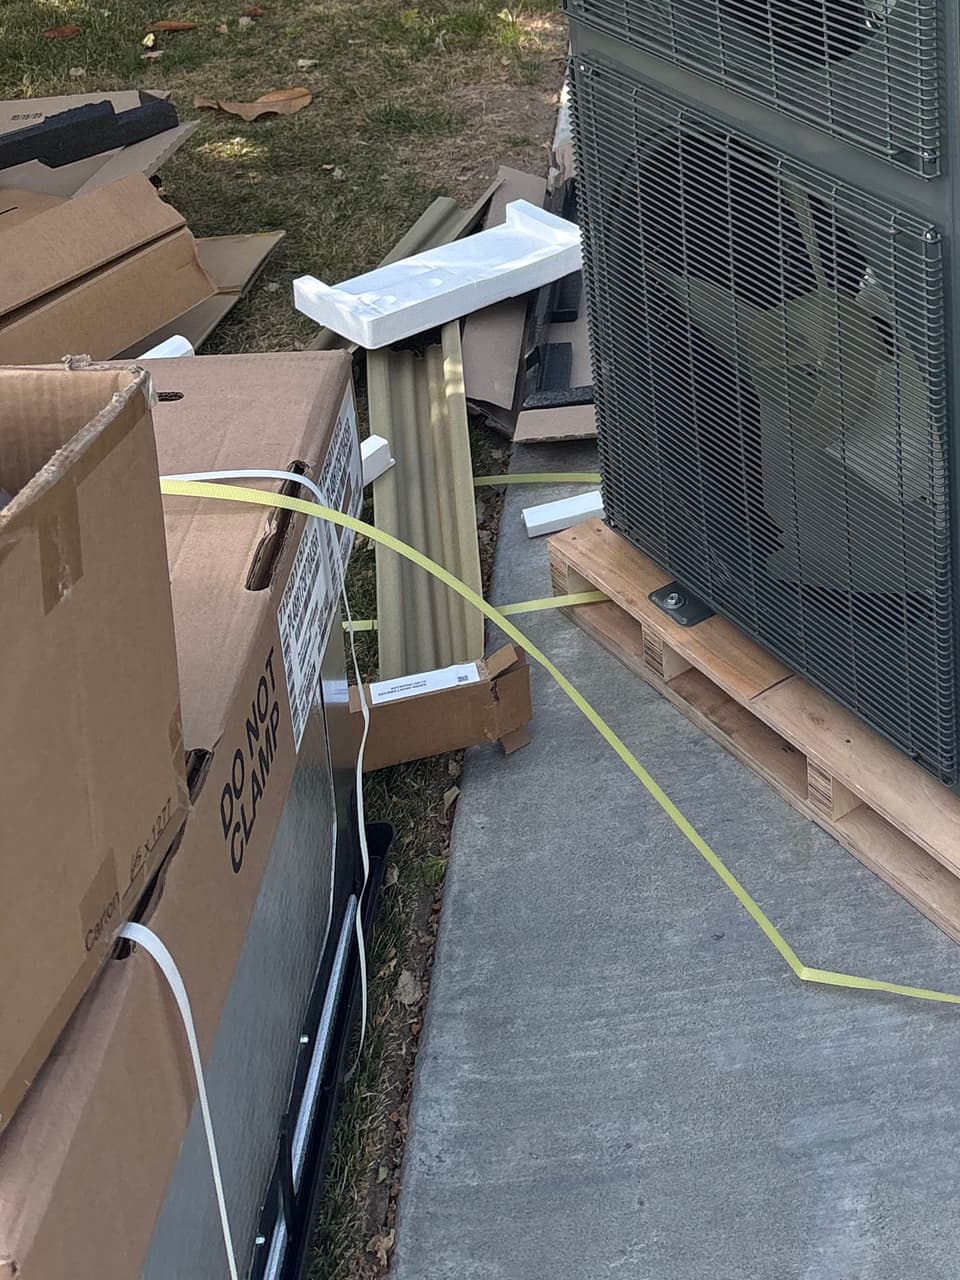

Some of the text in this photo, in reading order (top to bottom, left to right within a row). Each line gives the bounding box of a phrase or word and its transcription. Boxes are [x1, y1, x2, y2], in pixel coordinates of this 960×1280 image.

[220, 645, 276, 840] DO NOT
[230, 700, 280, 874] CLAMP
[85, 891, 120, 952] Carton
